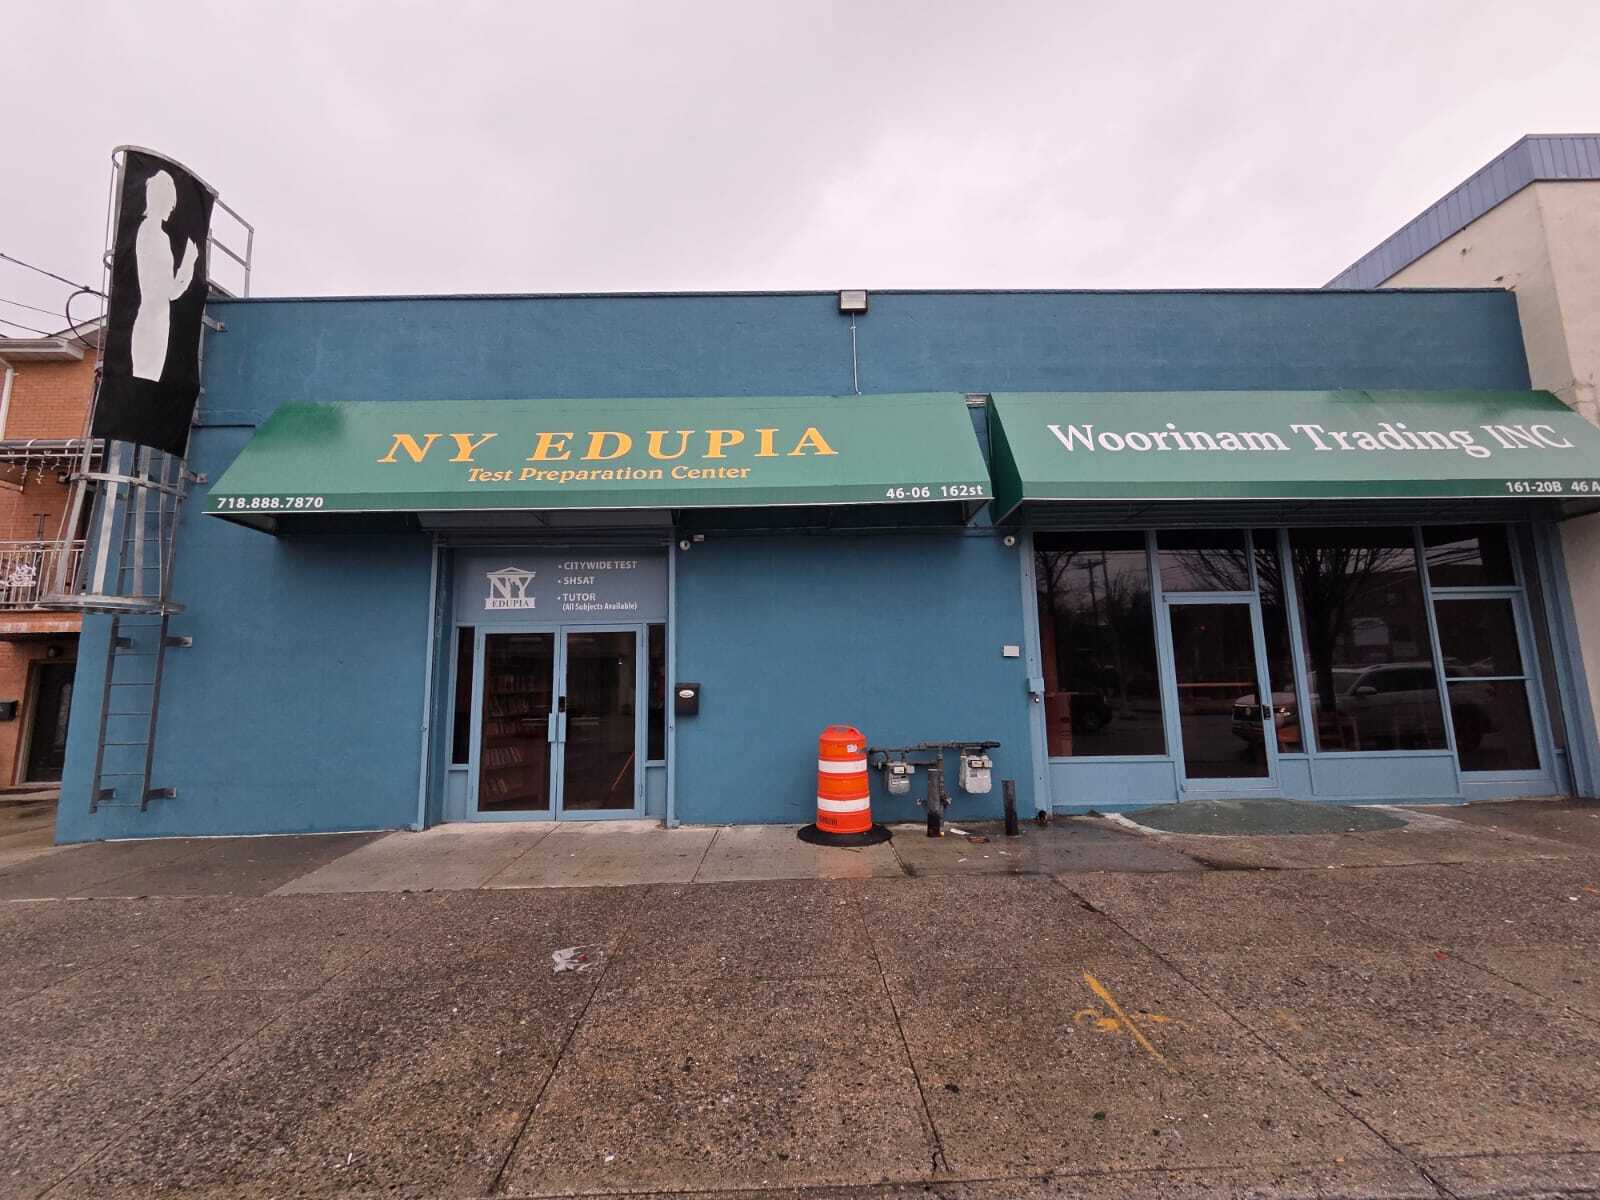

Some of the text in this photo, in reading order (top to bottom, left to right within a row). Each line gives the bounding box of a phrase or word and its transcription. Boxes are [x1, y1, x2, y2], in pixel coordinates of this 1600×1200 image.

[376, 426, 839, 464] NY EDUPIA
[1047, 423, 1575, 459] Woorinam Trading INC
[468, 465, 751, 484] Test Preparation Center
[885, 484, 984, 500] 46-06 162st
[1505, 481, 1563, 493] 161-20B
[1571, 481, 1589, 493] 46
[216, 496, 324, 510] 718.888.7870
[563, 560, 638, 571] CITYWIDE TEST
[487, 575, 536, 599] NY
[563, 576, 595, 585] SHSAT
[562, 592, 596, 602] TUTOR
[491, 600, 530, 608] EDUPIA
[575, 602, 604, 612] Subjects
[604, 601, 638, 611] Available)
